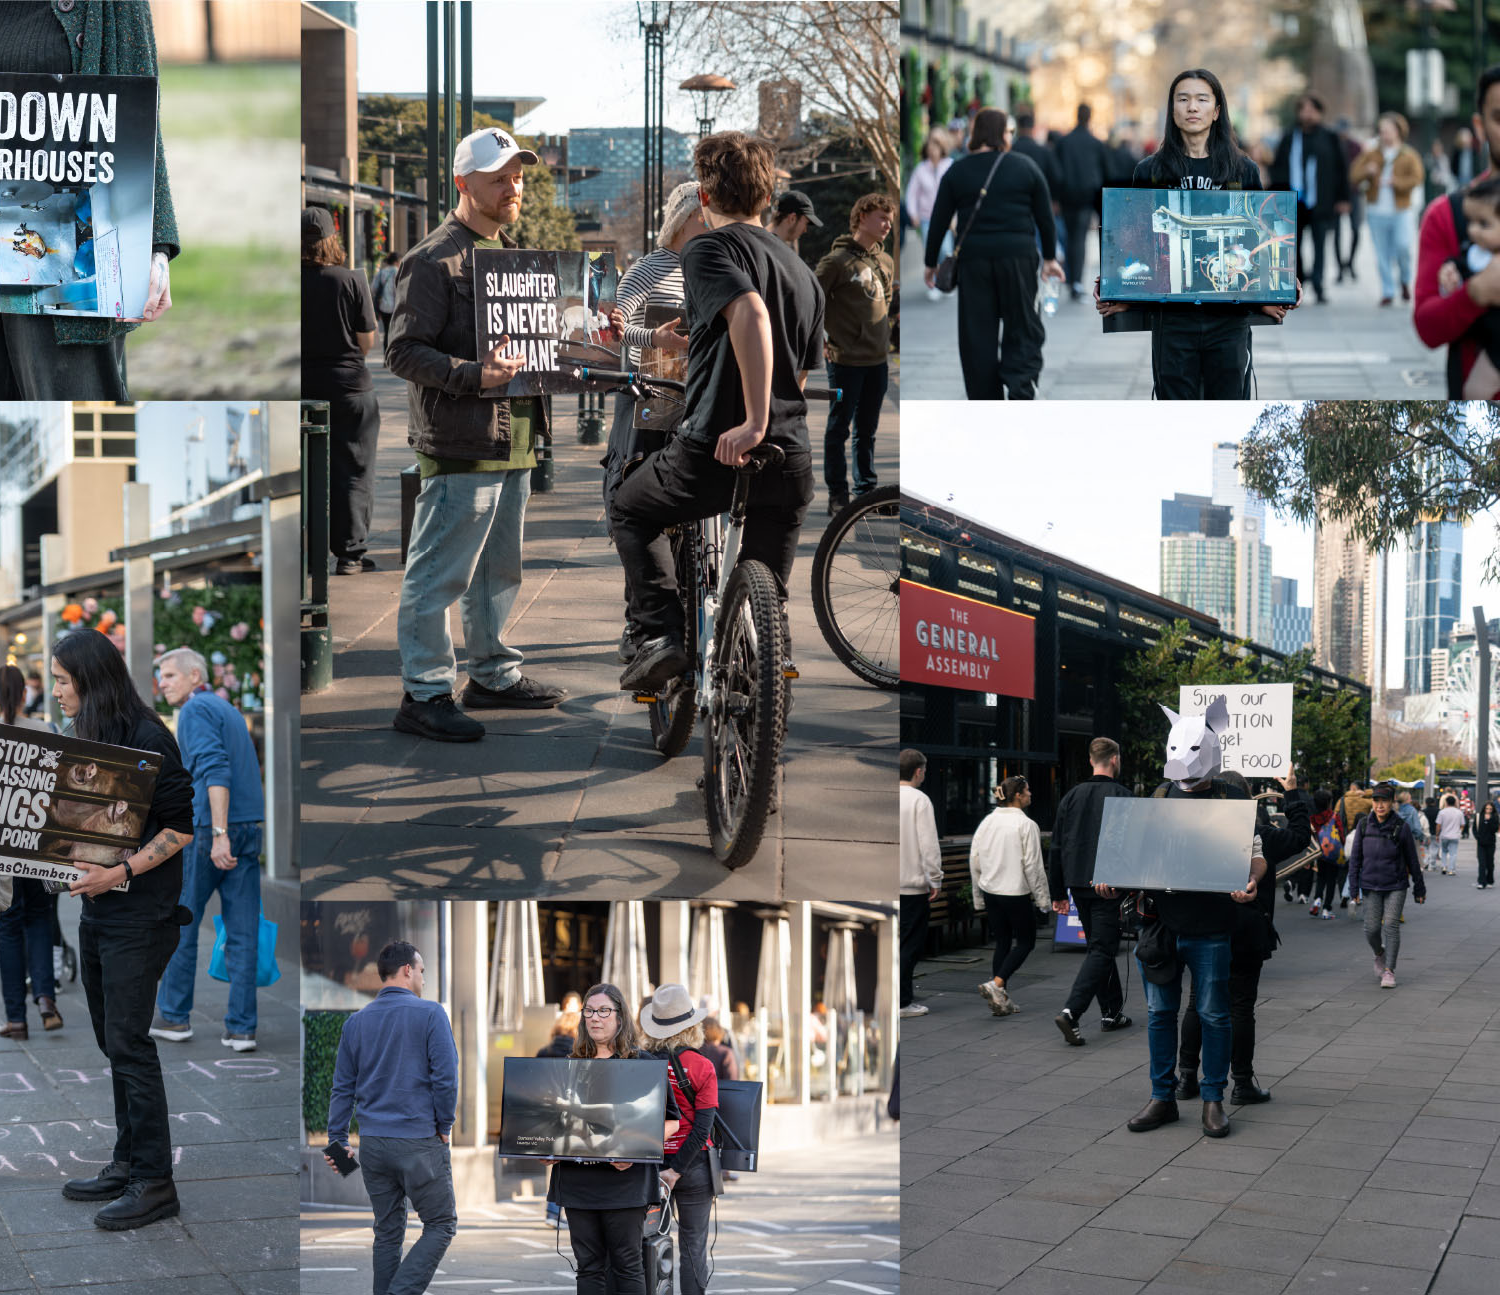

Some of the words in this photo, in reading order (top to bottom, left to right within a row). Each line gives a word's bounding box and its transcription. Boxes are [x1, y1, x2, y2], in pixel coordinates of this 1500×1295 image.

[485, 272, 557, 298] SLAUGHTER
[486, 302, 504, 335] IS
[507, 302, 558, 334] NEVER
[950, 608, 969, 625] THE
[916, 619, 1000, 661] GENERAL
[926, 654, 990, 680] ASSEMBLY
[1240, 693, 1268, 706] our
[1220, 732, 1243, 752] get
[1241, 753, 1283, 769] FOOD
[0, 828, 43, 851] PORK
